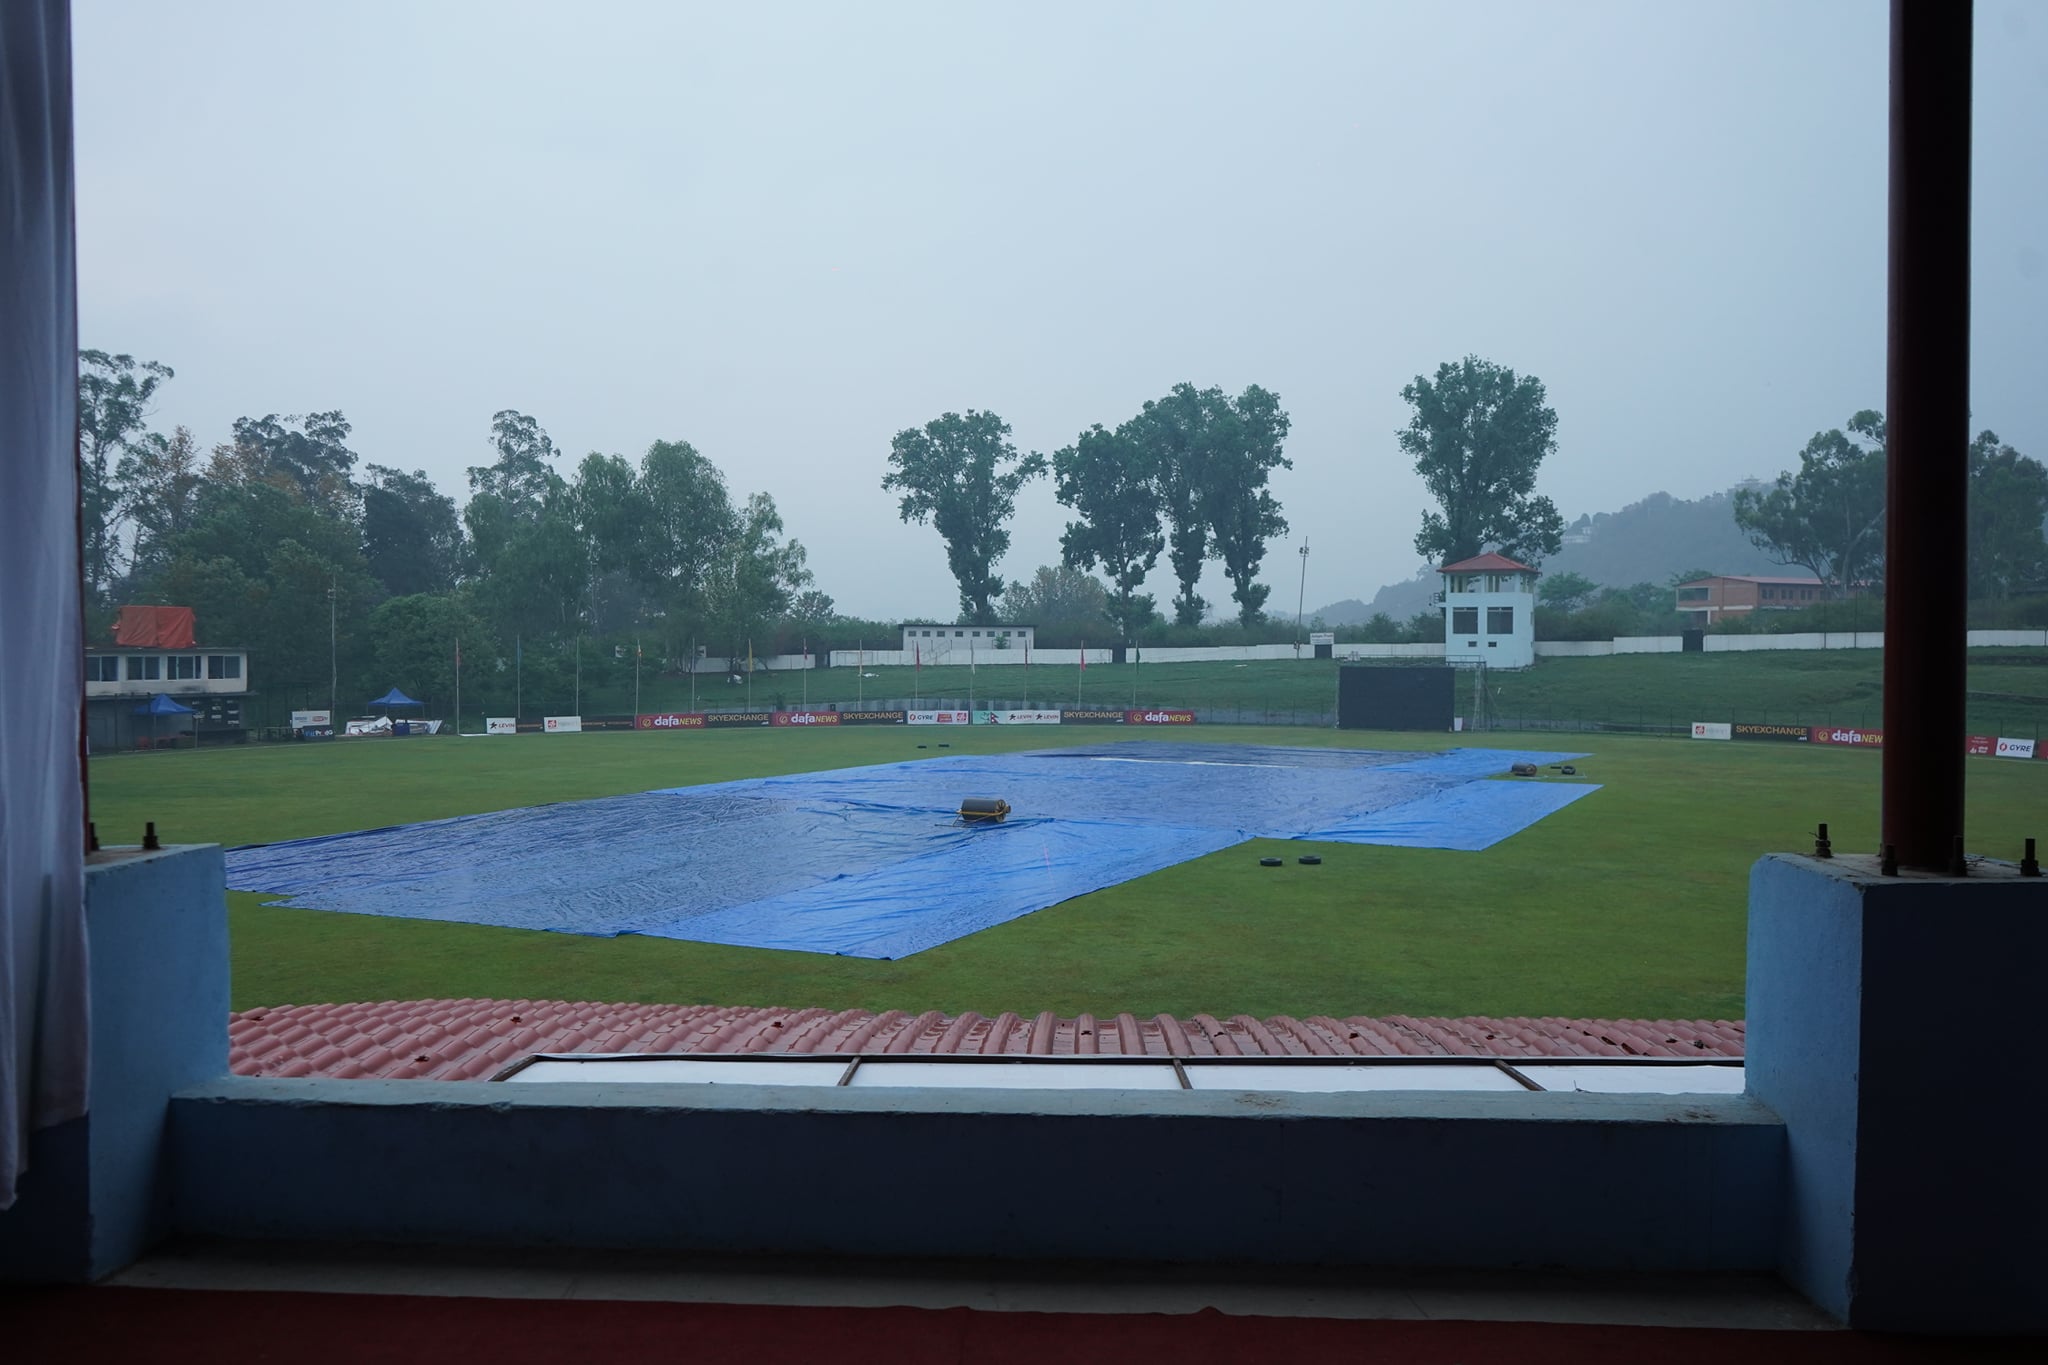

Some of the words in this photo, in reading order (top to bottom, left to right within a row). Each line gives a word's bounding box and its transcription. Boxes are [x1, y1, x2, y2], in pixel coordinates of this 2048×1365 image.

[708, 714, 769, 722] SKYEXCHANGE
[843, 712, 904, 720] SKYEXCHANGE
[1736, 725, 1807, 736] SKYEXCHANGE
[1832, 730, 1883, 744] dafaNEW
[2009, 744, 2031, 752] GYRE
